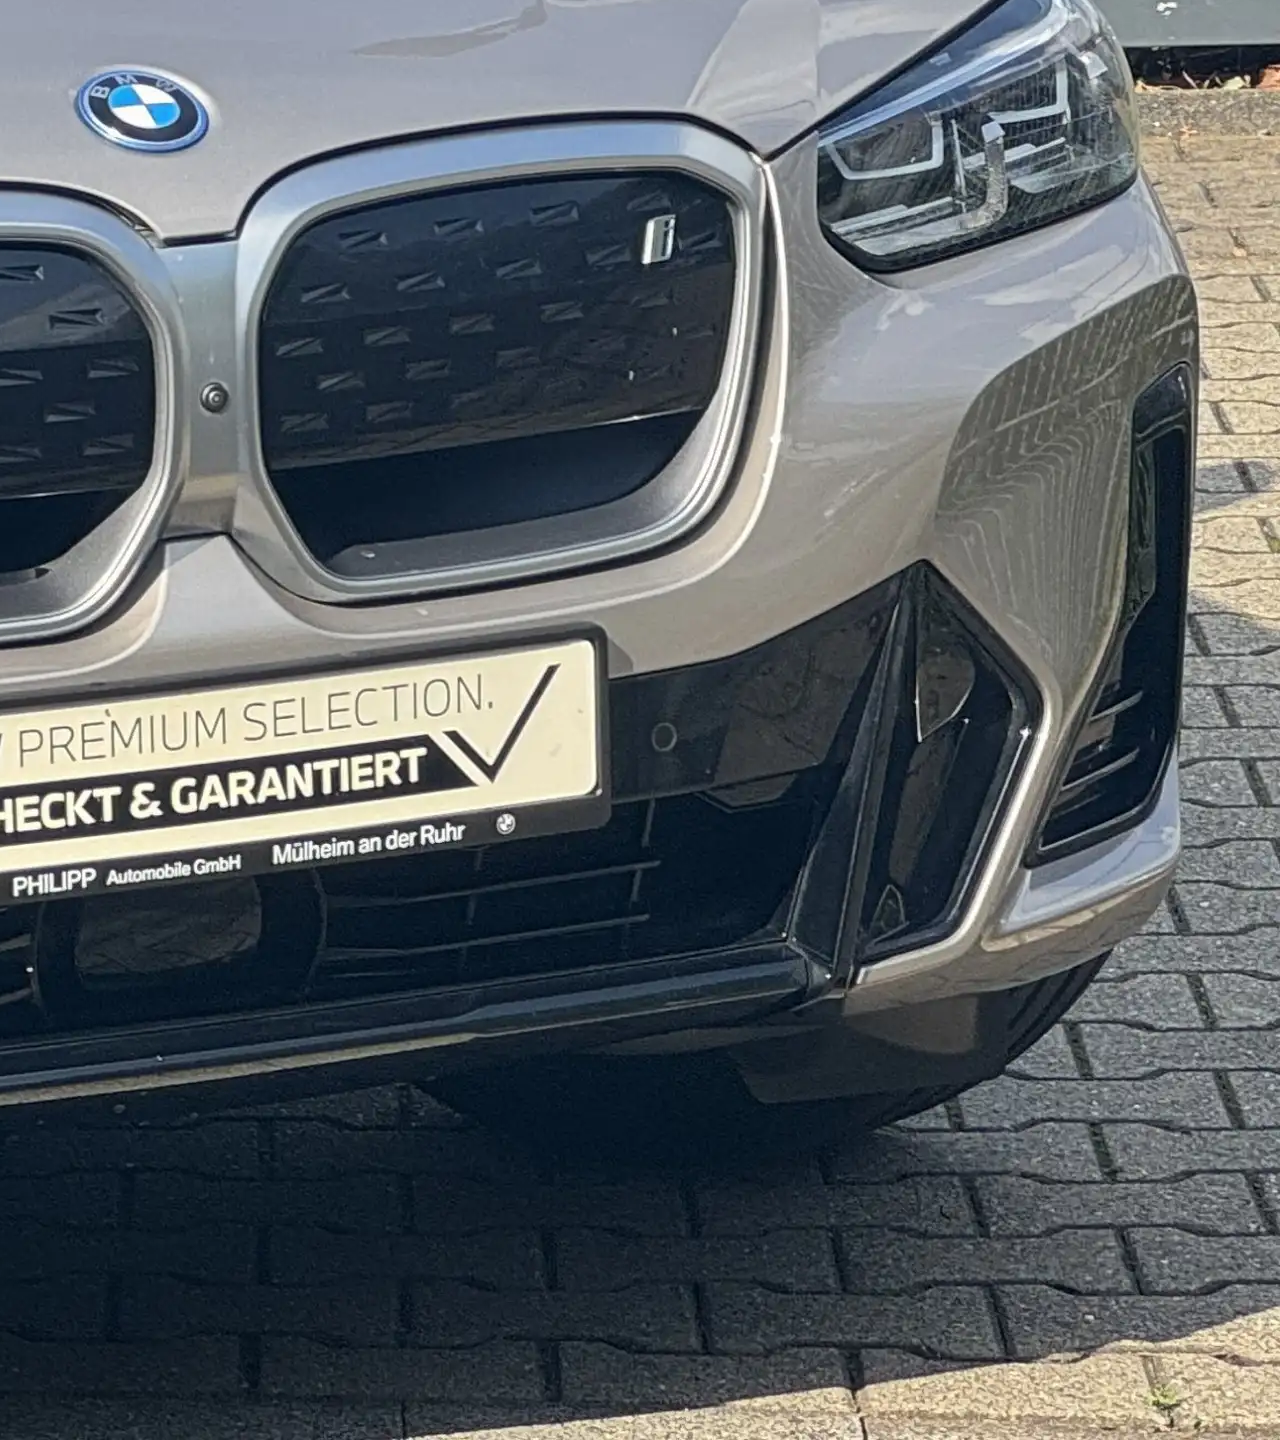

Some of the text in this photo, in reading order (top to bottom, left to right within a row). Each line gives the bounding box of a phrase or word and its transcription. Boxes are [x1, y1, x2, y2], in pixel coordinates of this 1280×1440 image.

[90, 73, 179, 100] BMW
[18, 706, 228, 768] PREMIUM
[242, 673, 494, 742] SELECTION.
[129, 781, 164, 820] &
[170, 746, 428, 815] GARANTIERT
[271, 822, 467, 865] Mülheim an der Ruhr
[12, 853, 242, 898] PHILIPP Automobile GmbH
